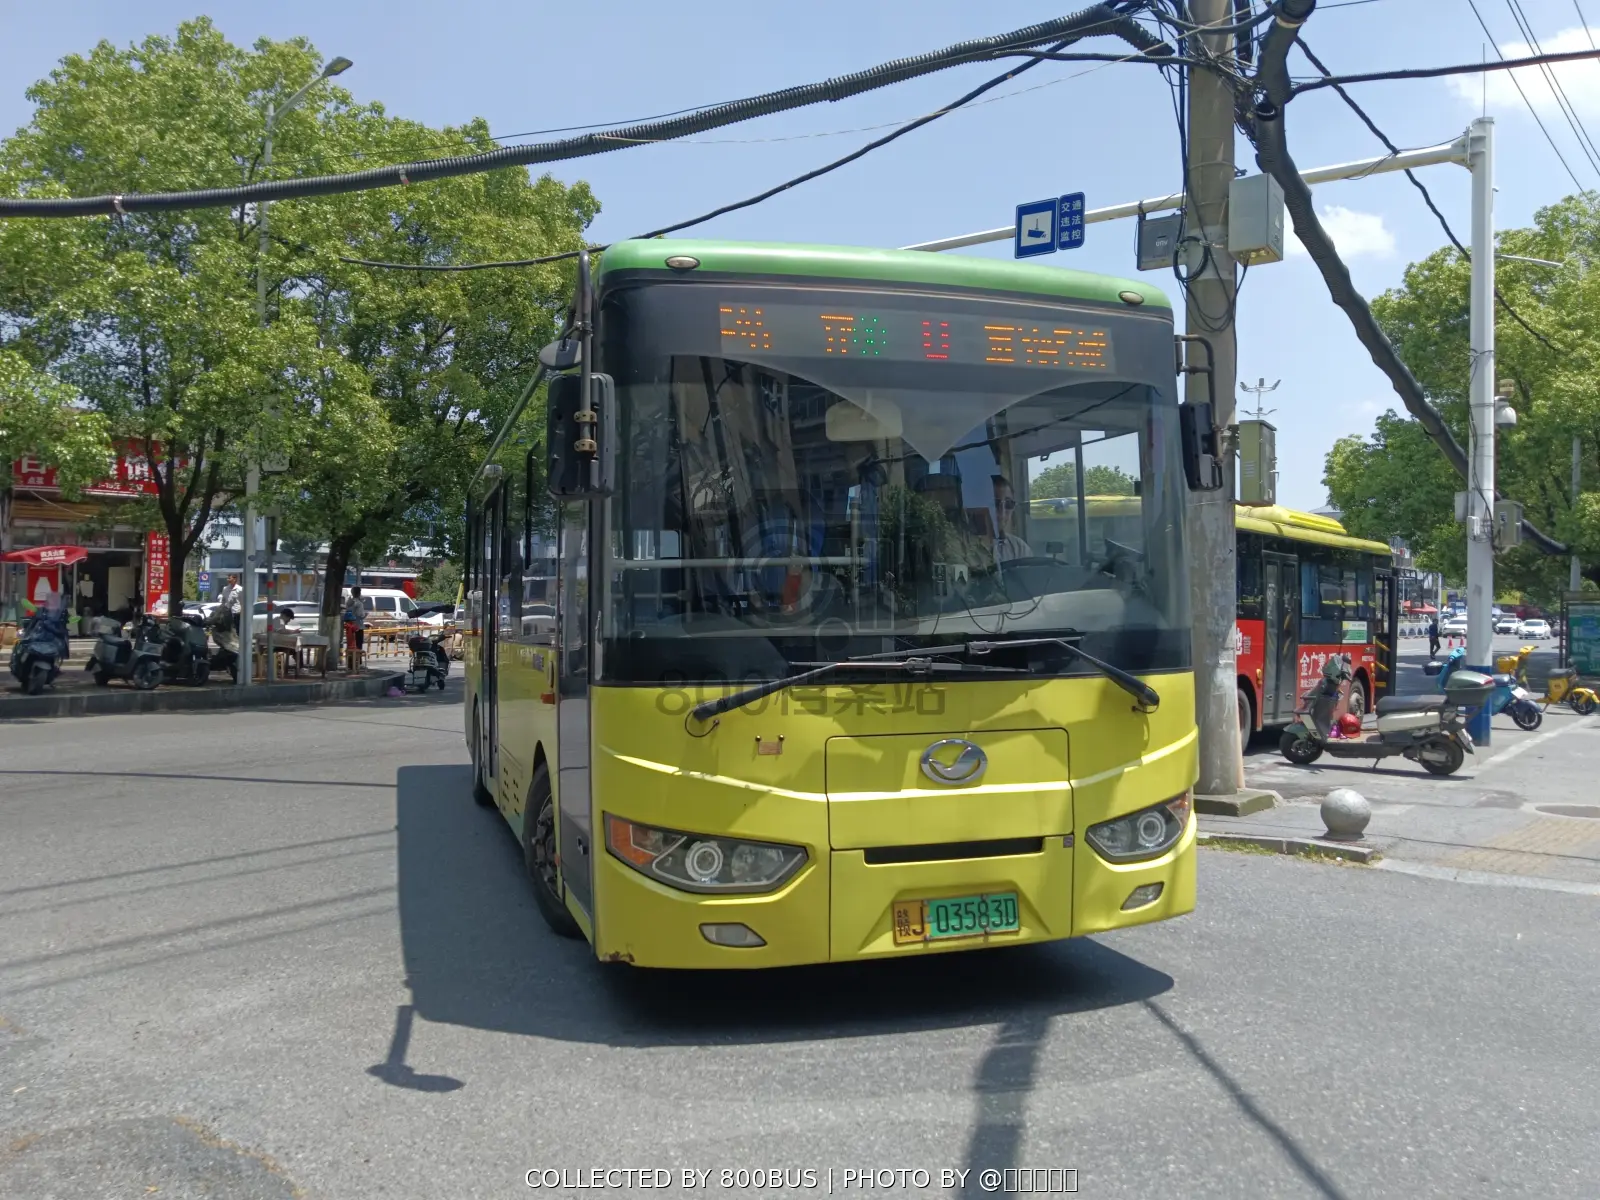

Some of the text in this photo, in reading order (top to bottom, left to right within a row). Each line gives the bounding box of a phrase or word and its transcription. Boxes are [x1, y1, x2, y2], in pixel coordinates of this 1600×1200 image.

[1060, 199, 1082, 213] 交通
[1060, 214, 1082, 227] 违法
[1059, 229, 1082, 242] 监控
